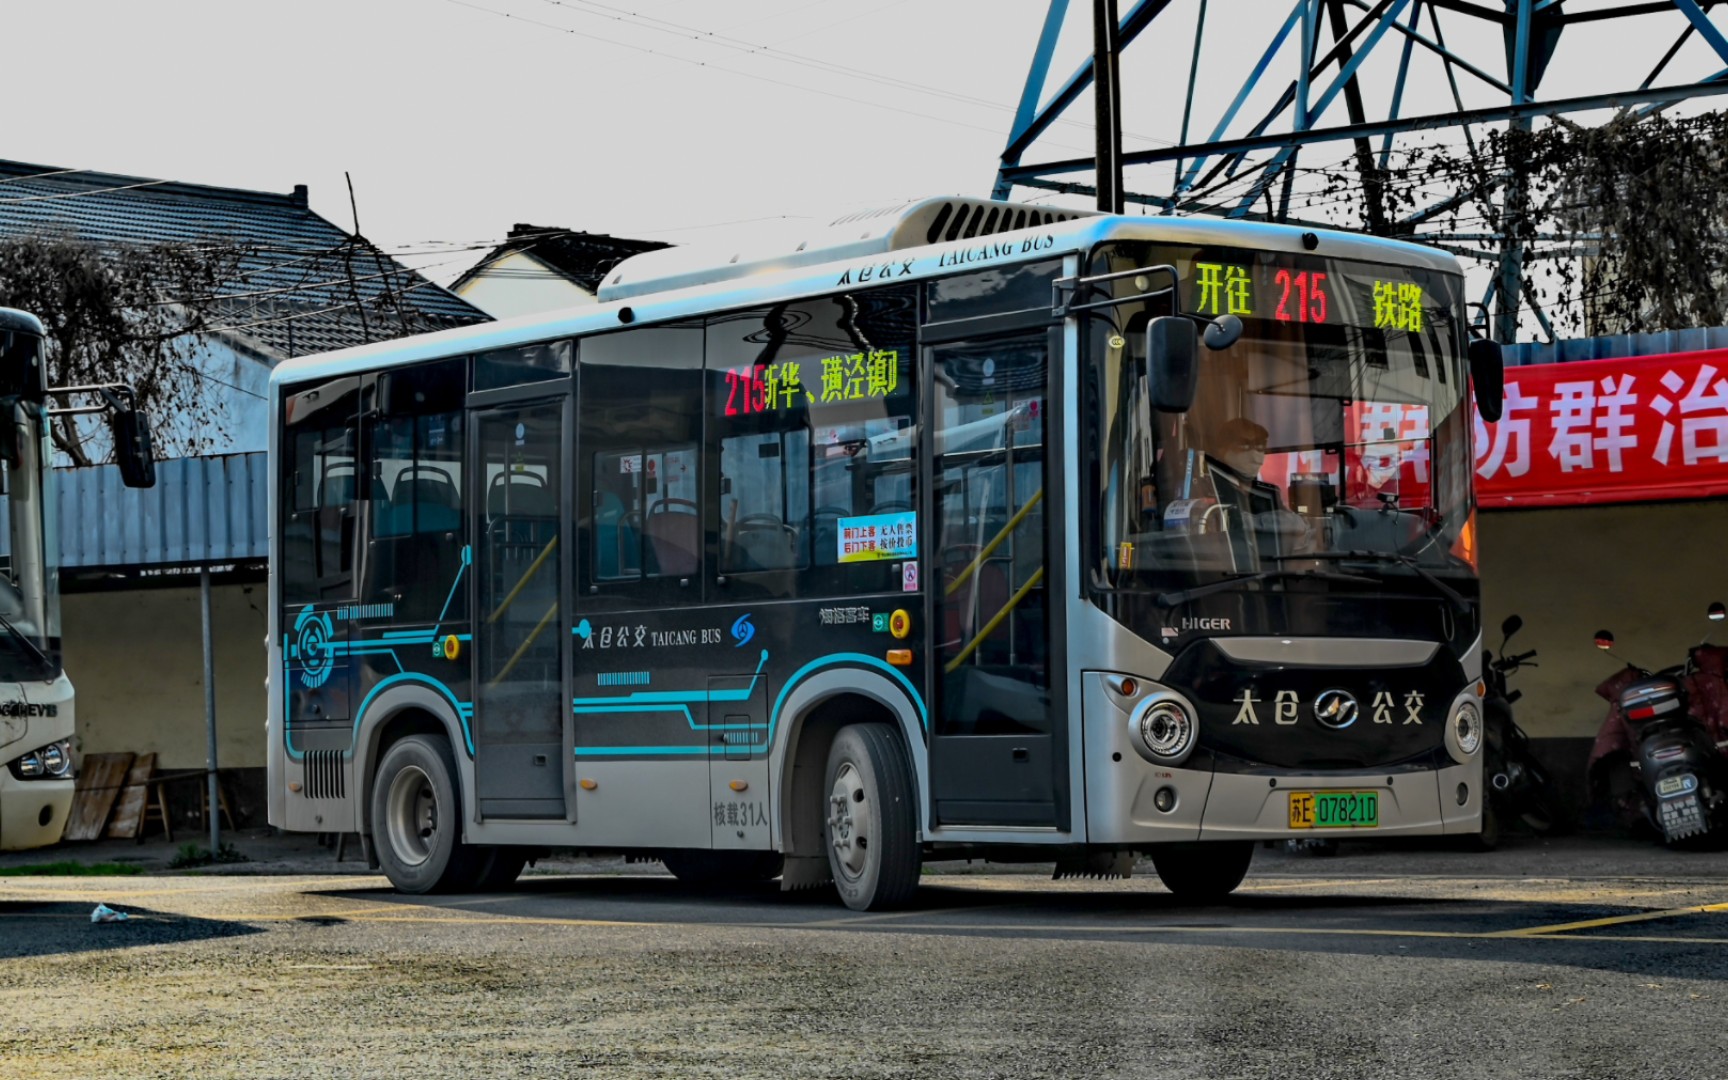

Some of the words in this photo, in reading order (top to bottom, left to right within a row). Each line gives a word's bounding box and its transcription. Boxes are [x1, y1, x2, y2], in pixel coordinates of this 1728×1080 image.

[1021, 234, 1054, 253] BUS
[1196, 263, 1252, 315] 开往
[1275, 269, 1327, 323] 215
[1373, 280, 1422, 332] 铁路
[725, 364, 766, 416] 215
[844, 526, 876, 539] 前门上客
[844, 540, 876, 553] 后门下客
[1182, 617, 1231, 630] HIGER
[651, 629, 696, 646] TAICANG
[701, 628, 721, 644] BUS
[1232, 689, 1300, 725] 太仓
[1371, 690, 1425, 725] 公交
[714, 801, 768, 827] 核载31人
[1319, 797, 1376, 822] 07821D
